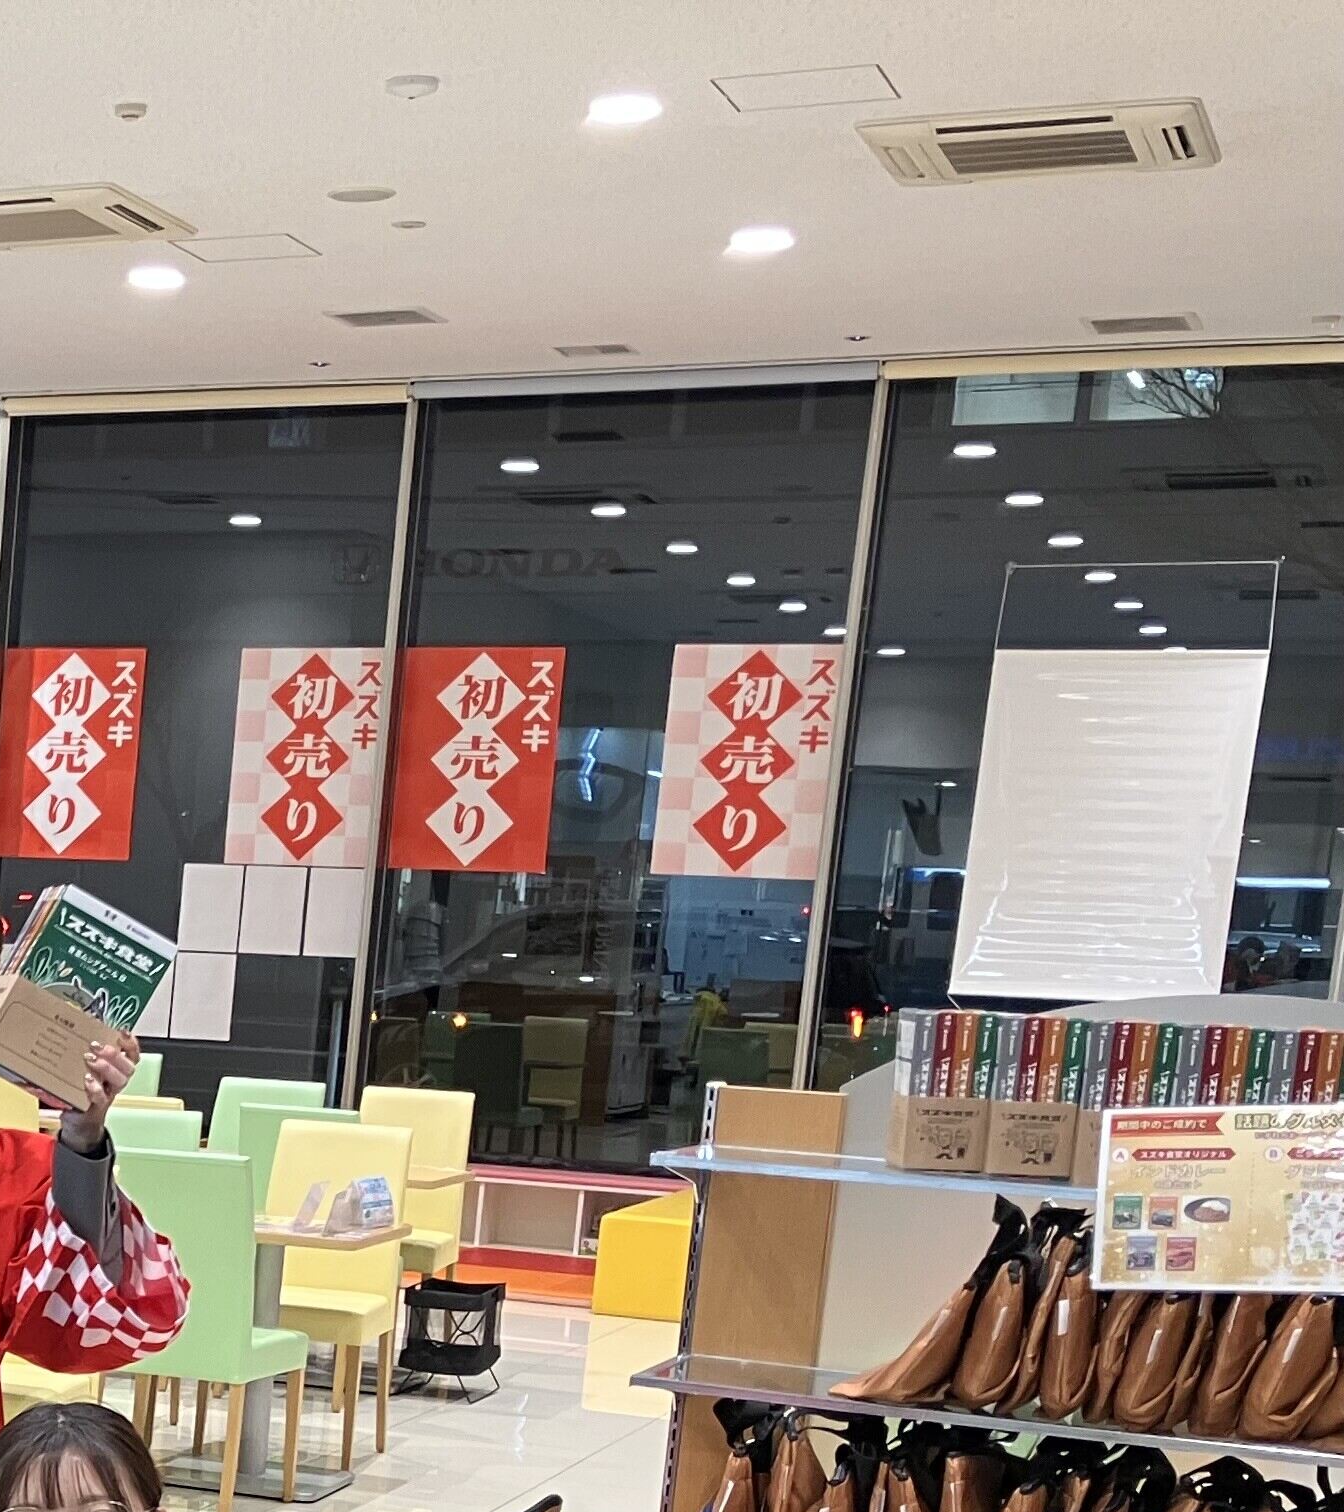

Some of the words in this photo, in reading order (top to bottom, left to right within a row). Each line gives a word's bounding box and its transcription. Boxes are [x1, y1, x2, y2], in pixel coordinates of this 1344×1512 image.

[44, 673, 95, 836] 初売り
[107, 660, 137, 748] スズキ
[282, 674, 337, 842] 初売り
[351, 661, 383, 750] スズキ
[449, 674, 507, 847] 初売り
[520, 661, 554, 752] スズキ
[718, 671, 785, 852] 初売り
[798, 659, 836, 754] スズキ
